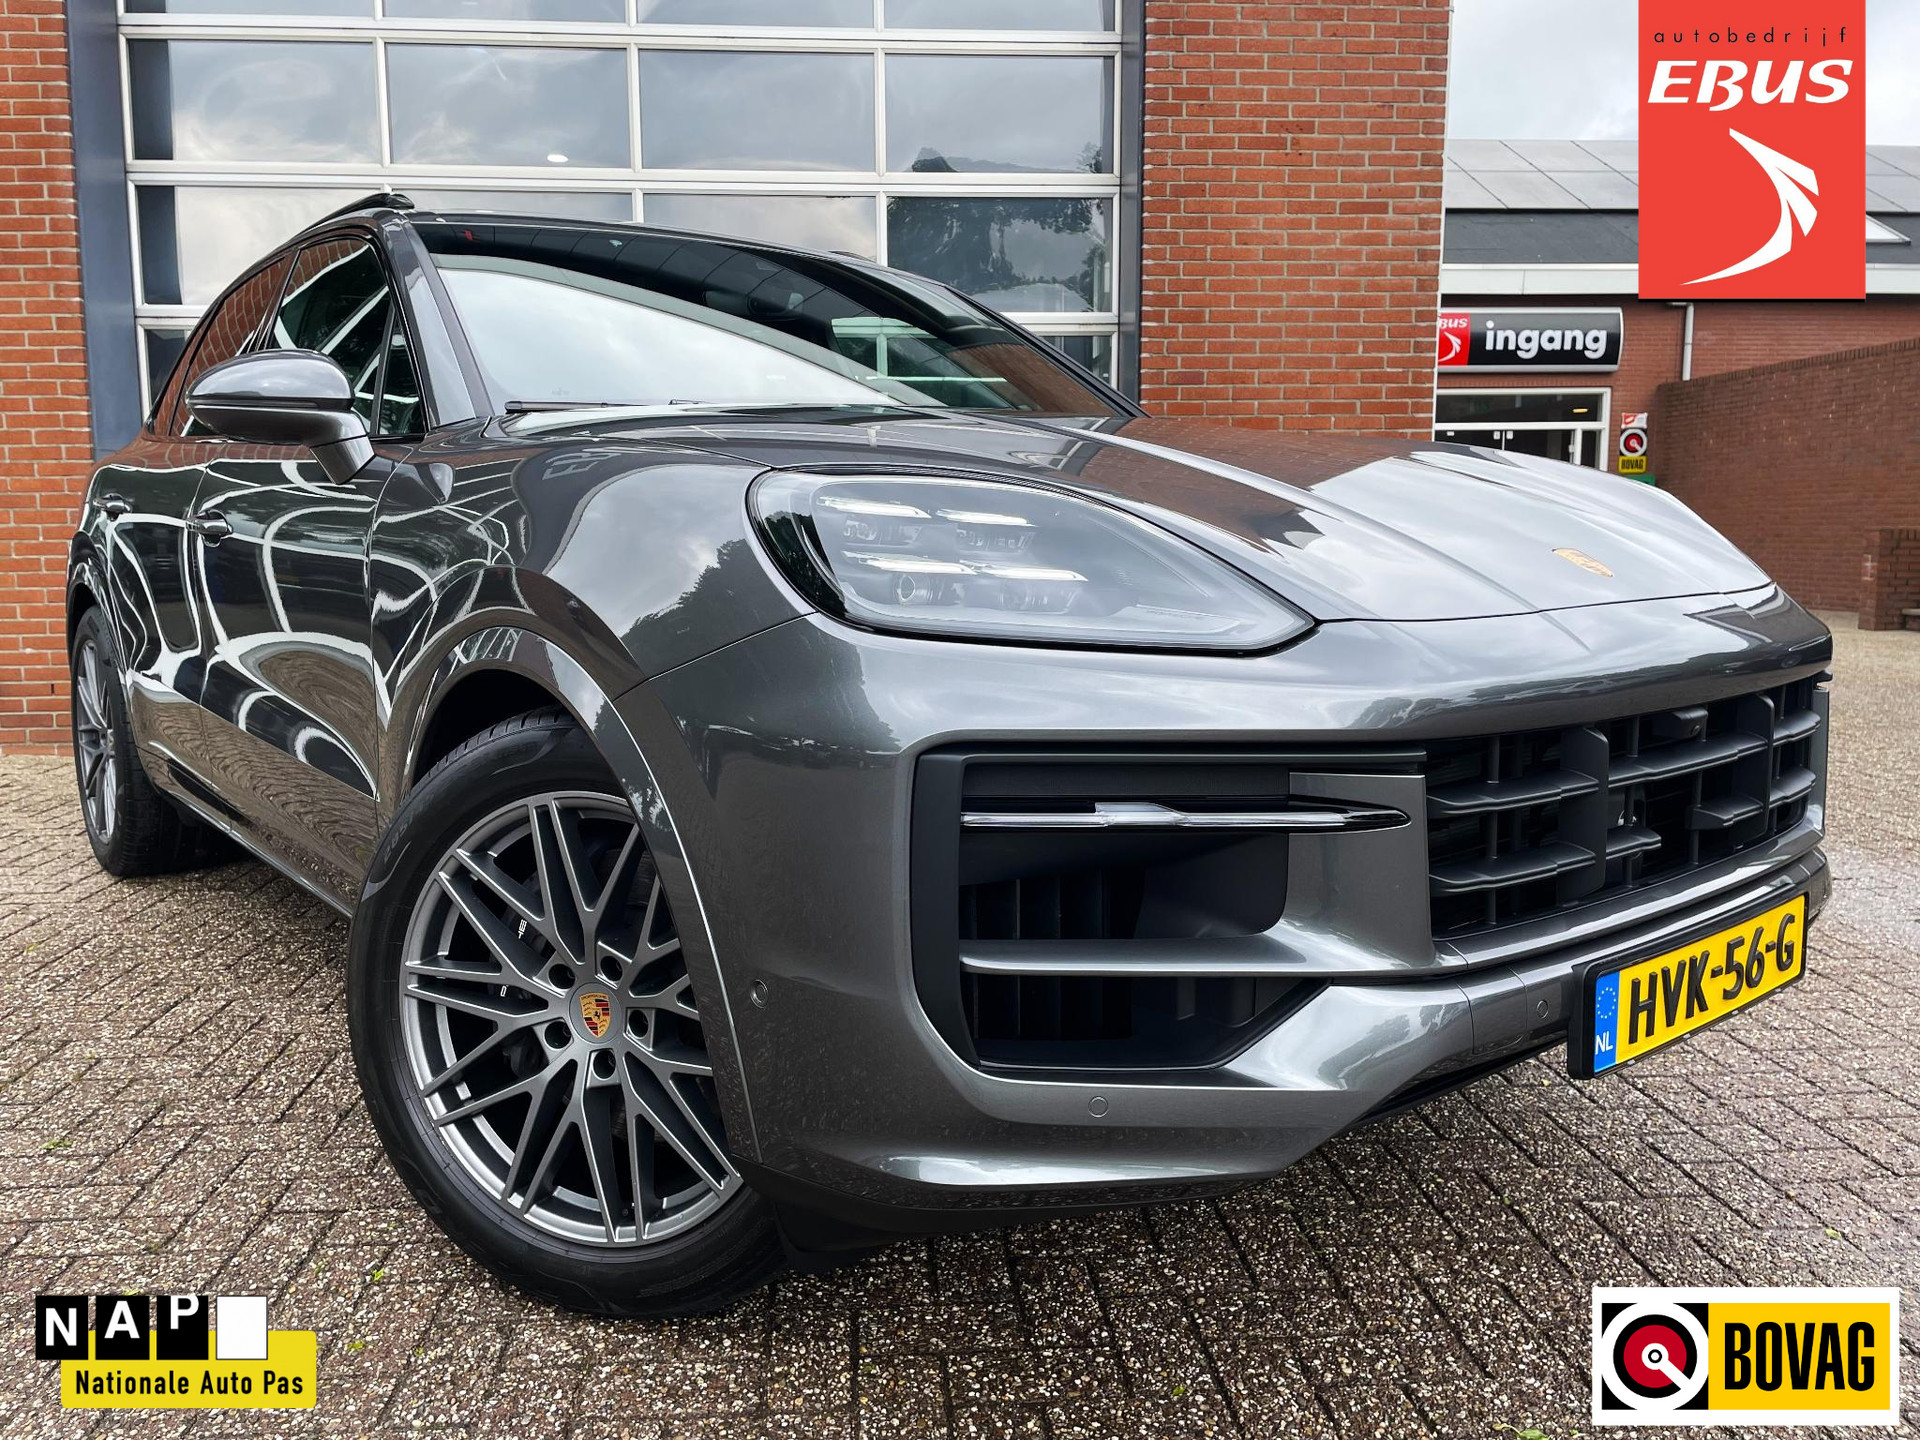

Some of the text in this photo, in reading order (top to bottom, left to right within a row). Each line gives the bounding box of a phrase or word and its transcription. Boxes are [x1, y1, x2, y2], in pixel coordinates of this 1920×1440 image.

[1439, 318, 1468, 330] BUS
[1485, 319, 1608, 360] ingang
[1628, 913, 1796, 1045] HVK-56-G
[1594, 1031, 1614, 1055] NL
